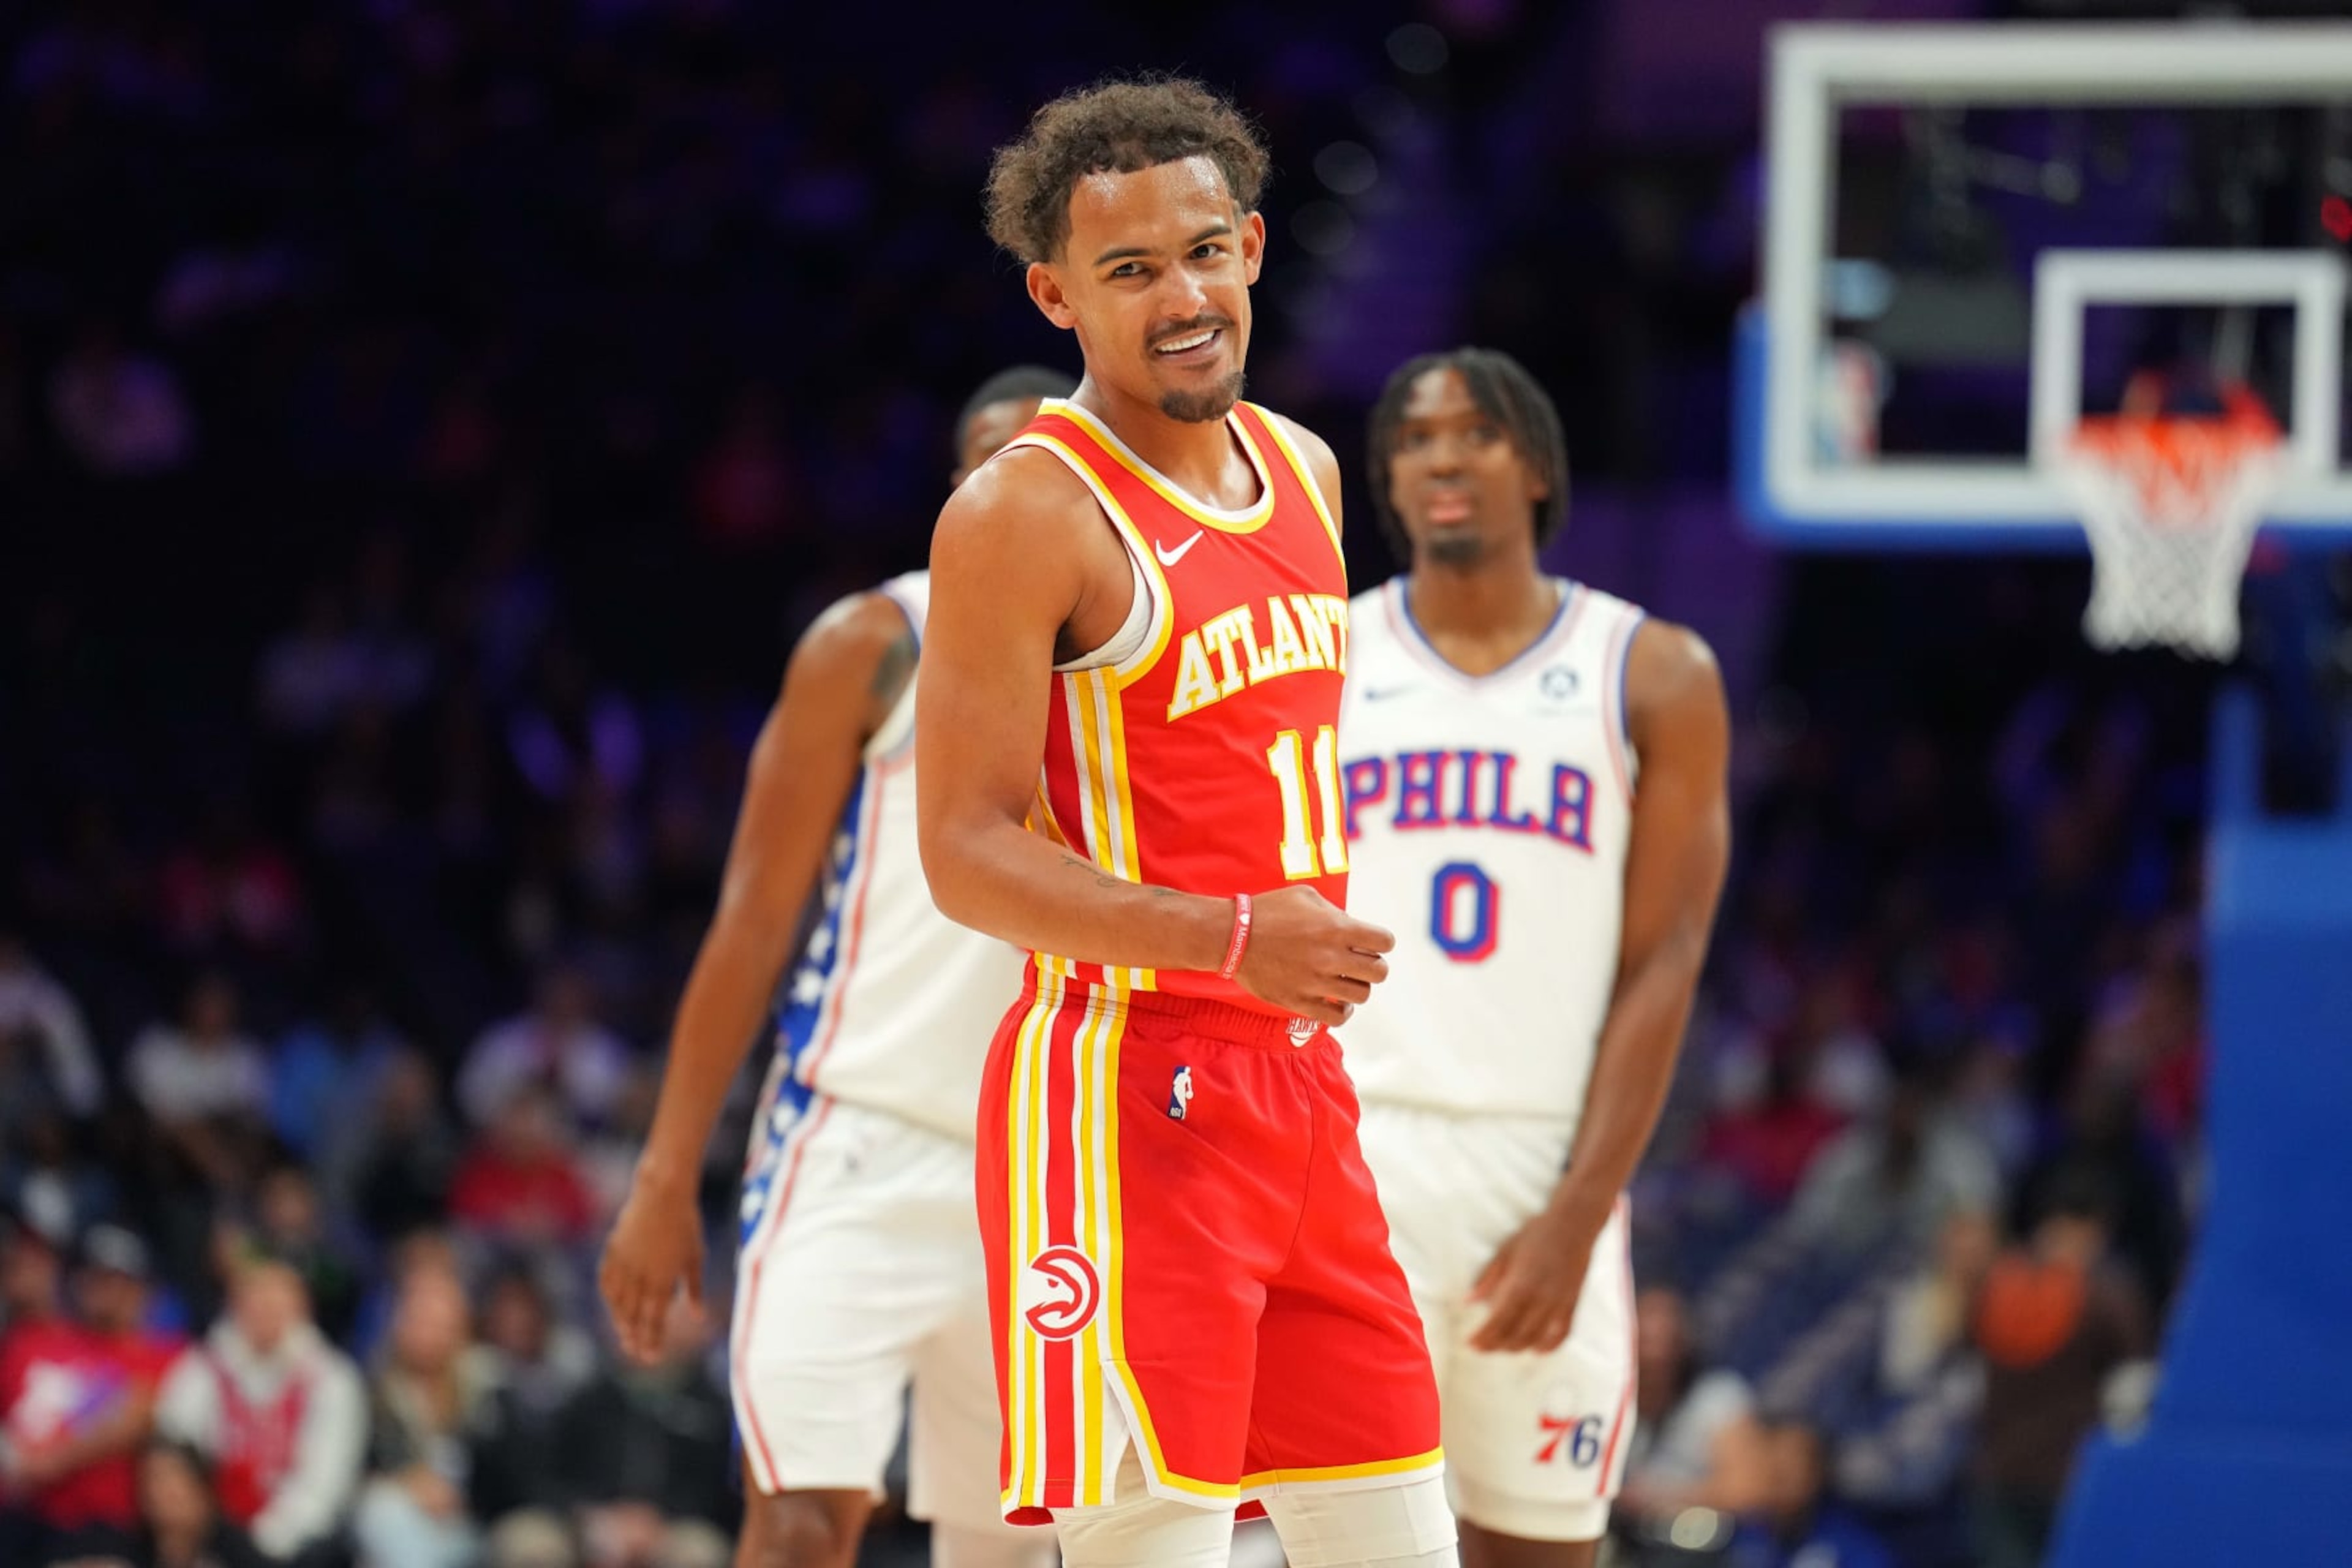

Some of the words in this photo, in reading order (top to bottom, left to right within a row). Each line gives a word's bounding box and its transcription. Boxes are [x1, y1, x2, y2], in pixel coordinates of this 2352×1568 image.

[1266, 725, 1349, 880] 11
[1344, 750, 1594, 855] PHILA
[1431, 862, 1499, 963] 0
[1534, 1414, 1602, 1468] 76
